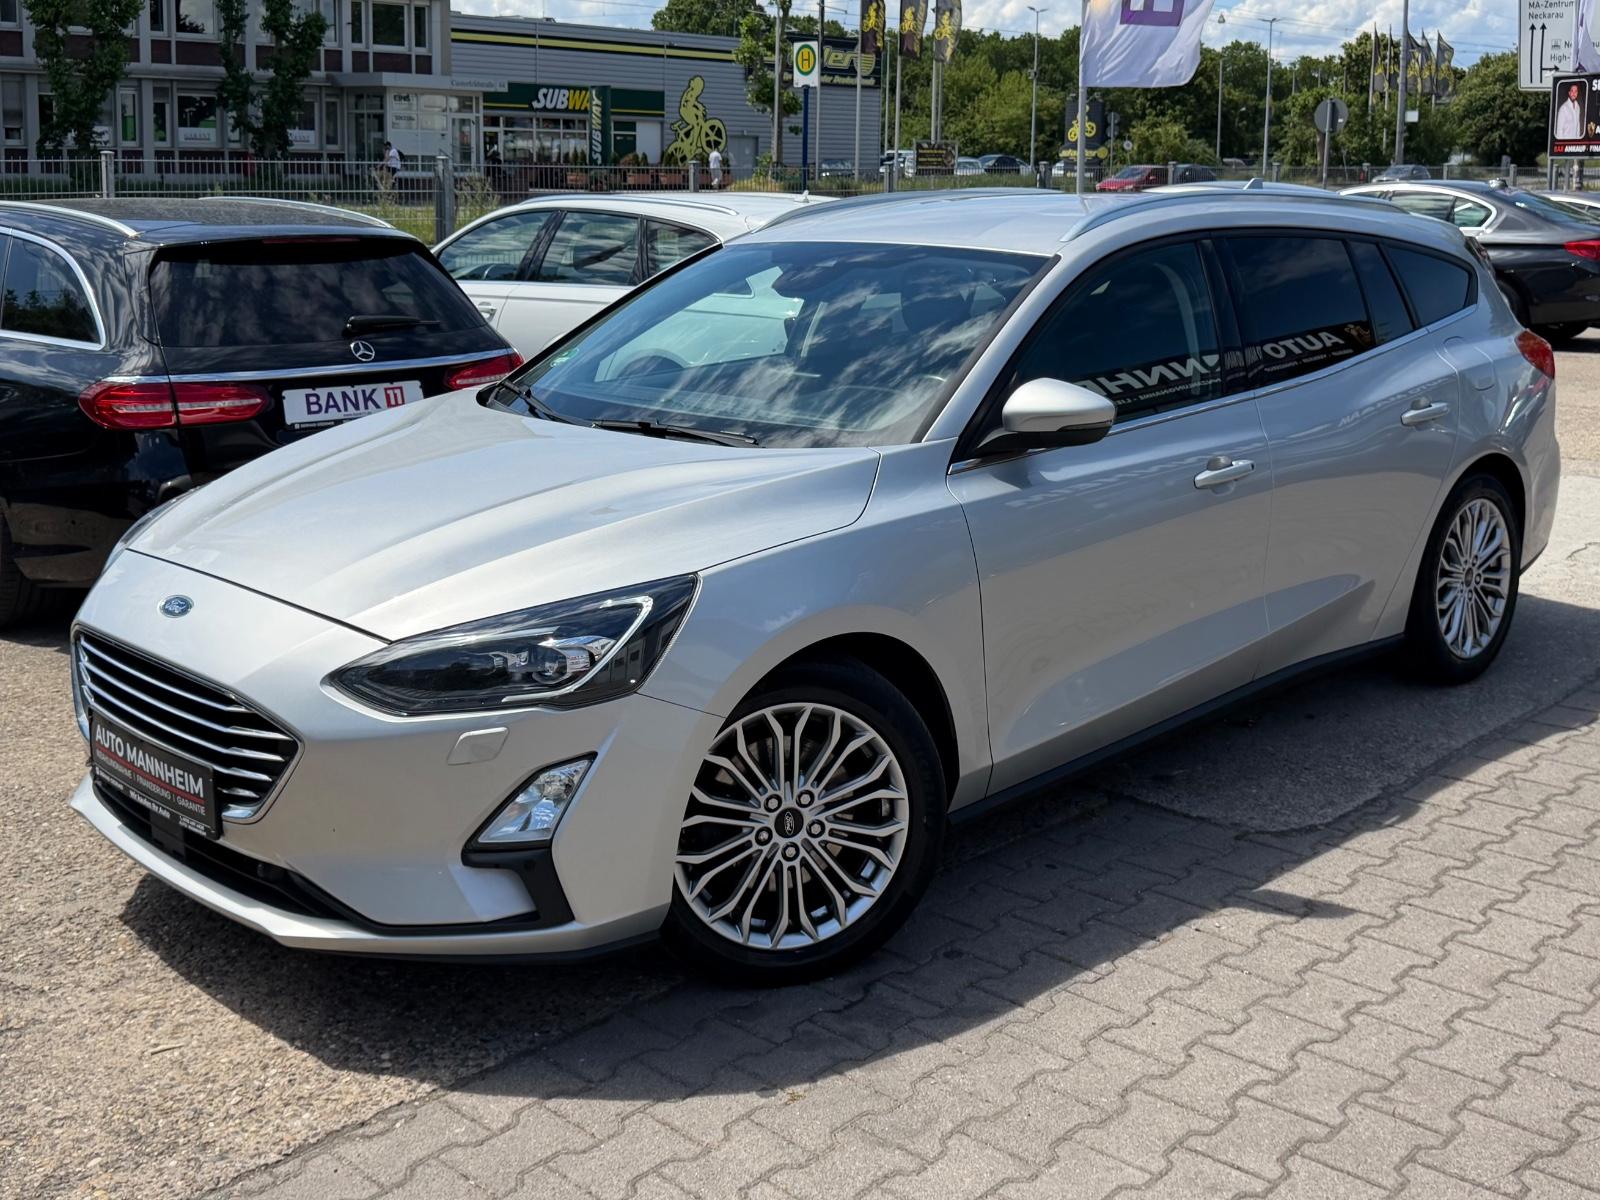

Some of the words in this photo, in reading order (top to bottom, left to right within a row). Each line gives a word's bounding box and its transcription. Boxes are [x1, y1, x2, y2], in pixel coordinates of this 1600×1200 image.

[1528, 11, 1564, 20] Neckarau
[532, 87, 591, 110] SUBWA
[591, 89, 602, 165] SUBWAY
[304, 388, 382, 416] BANK
[95, 724, 124, 757] AUTO
[126, 743, 204, 798] MANNHEIM
